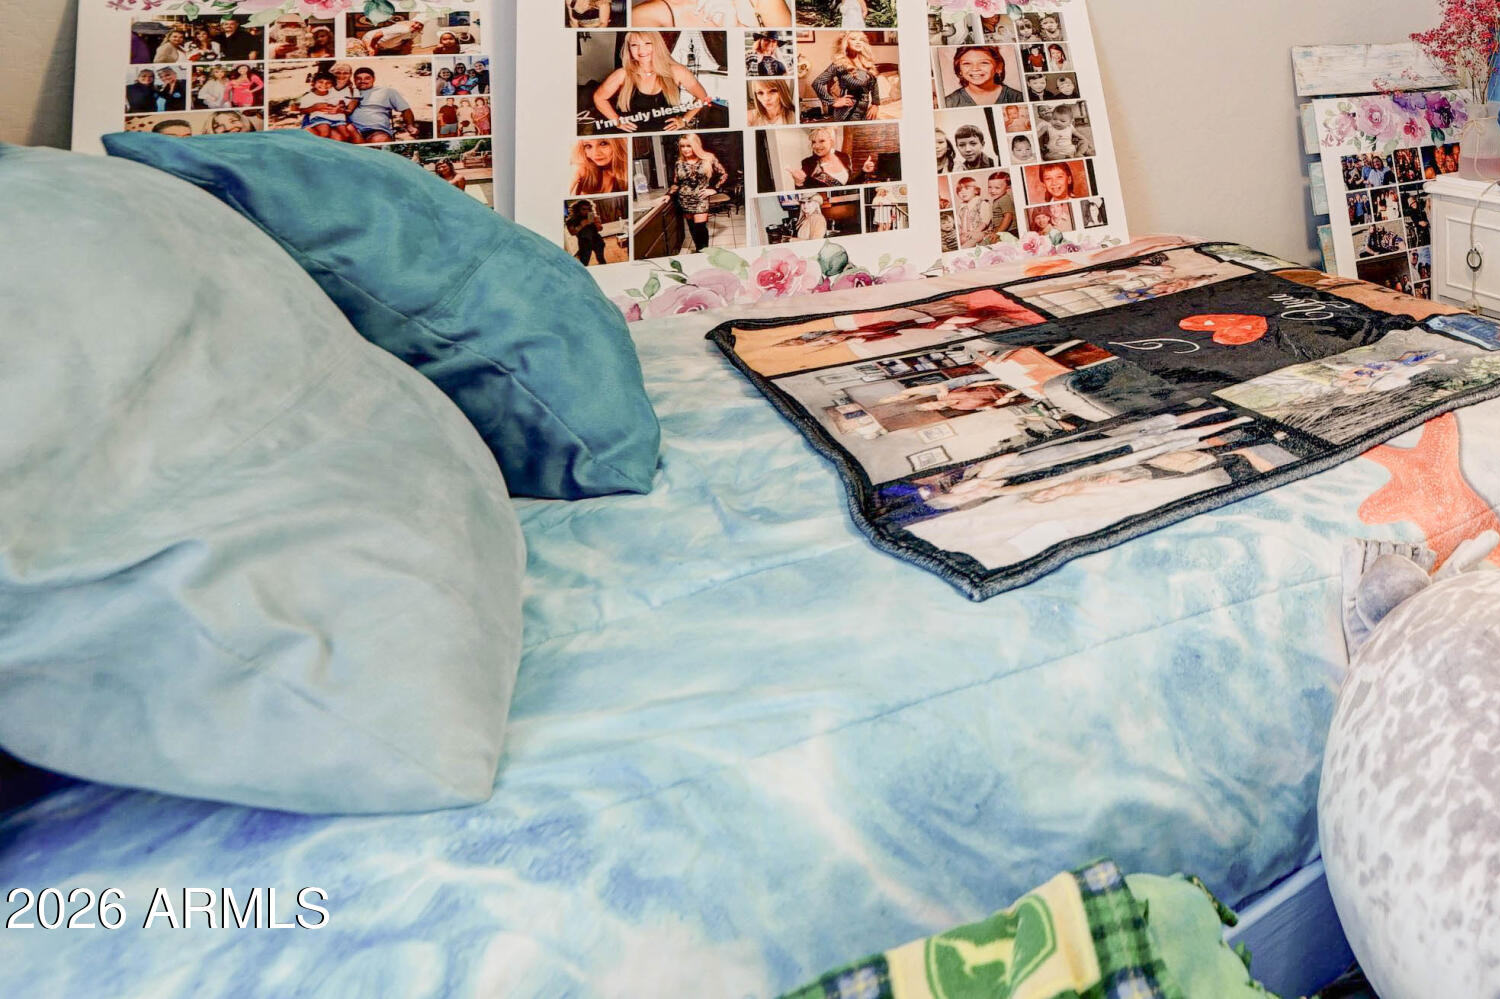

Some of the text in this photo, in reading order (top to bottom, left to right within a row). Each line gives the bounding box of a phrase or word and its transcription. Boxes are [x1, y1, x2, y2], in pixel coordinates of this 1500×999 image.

[595, 99, 703, 130] I'm truly blessed
